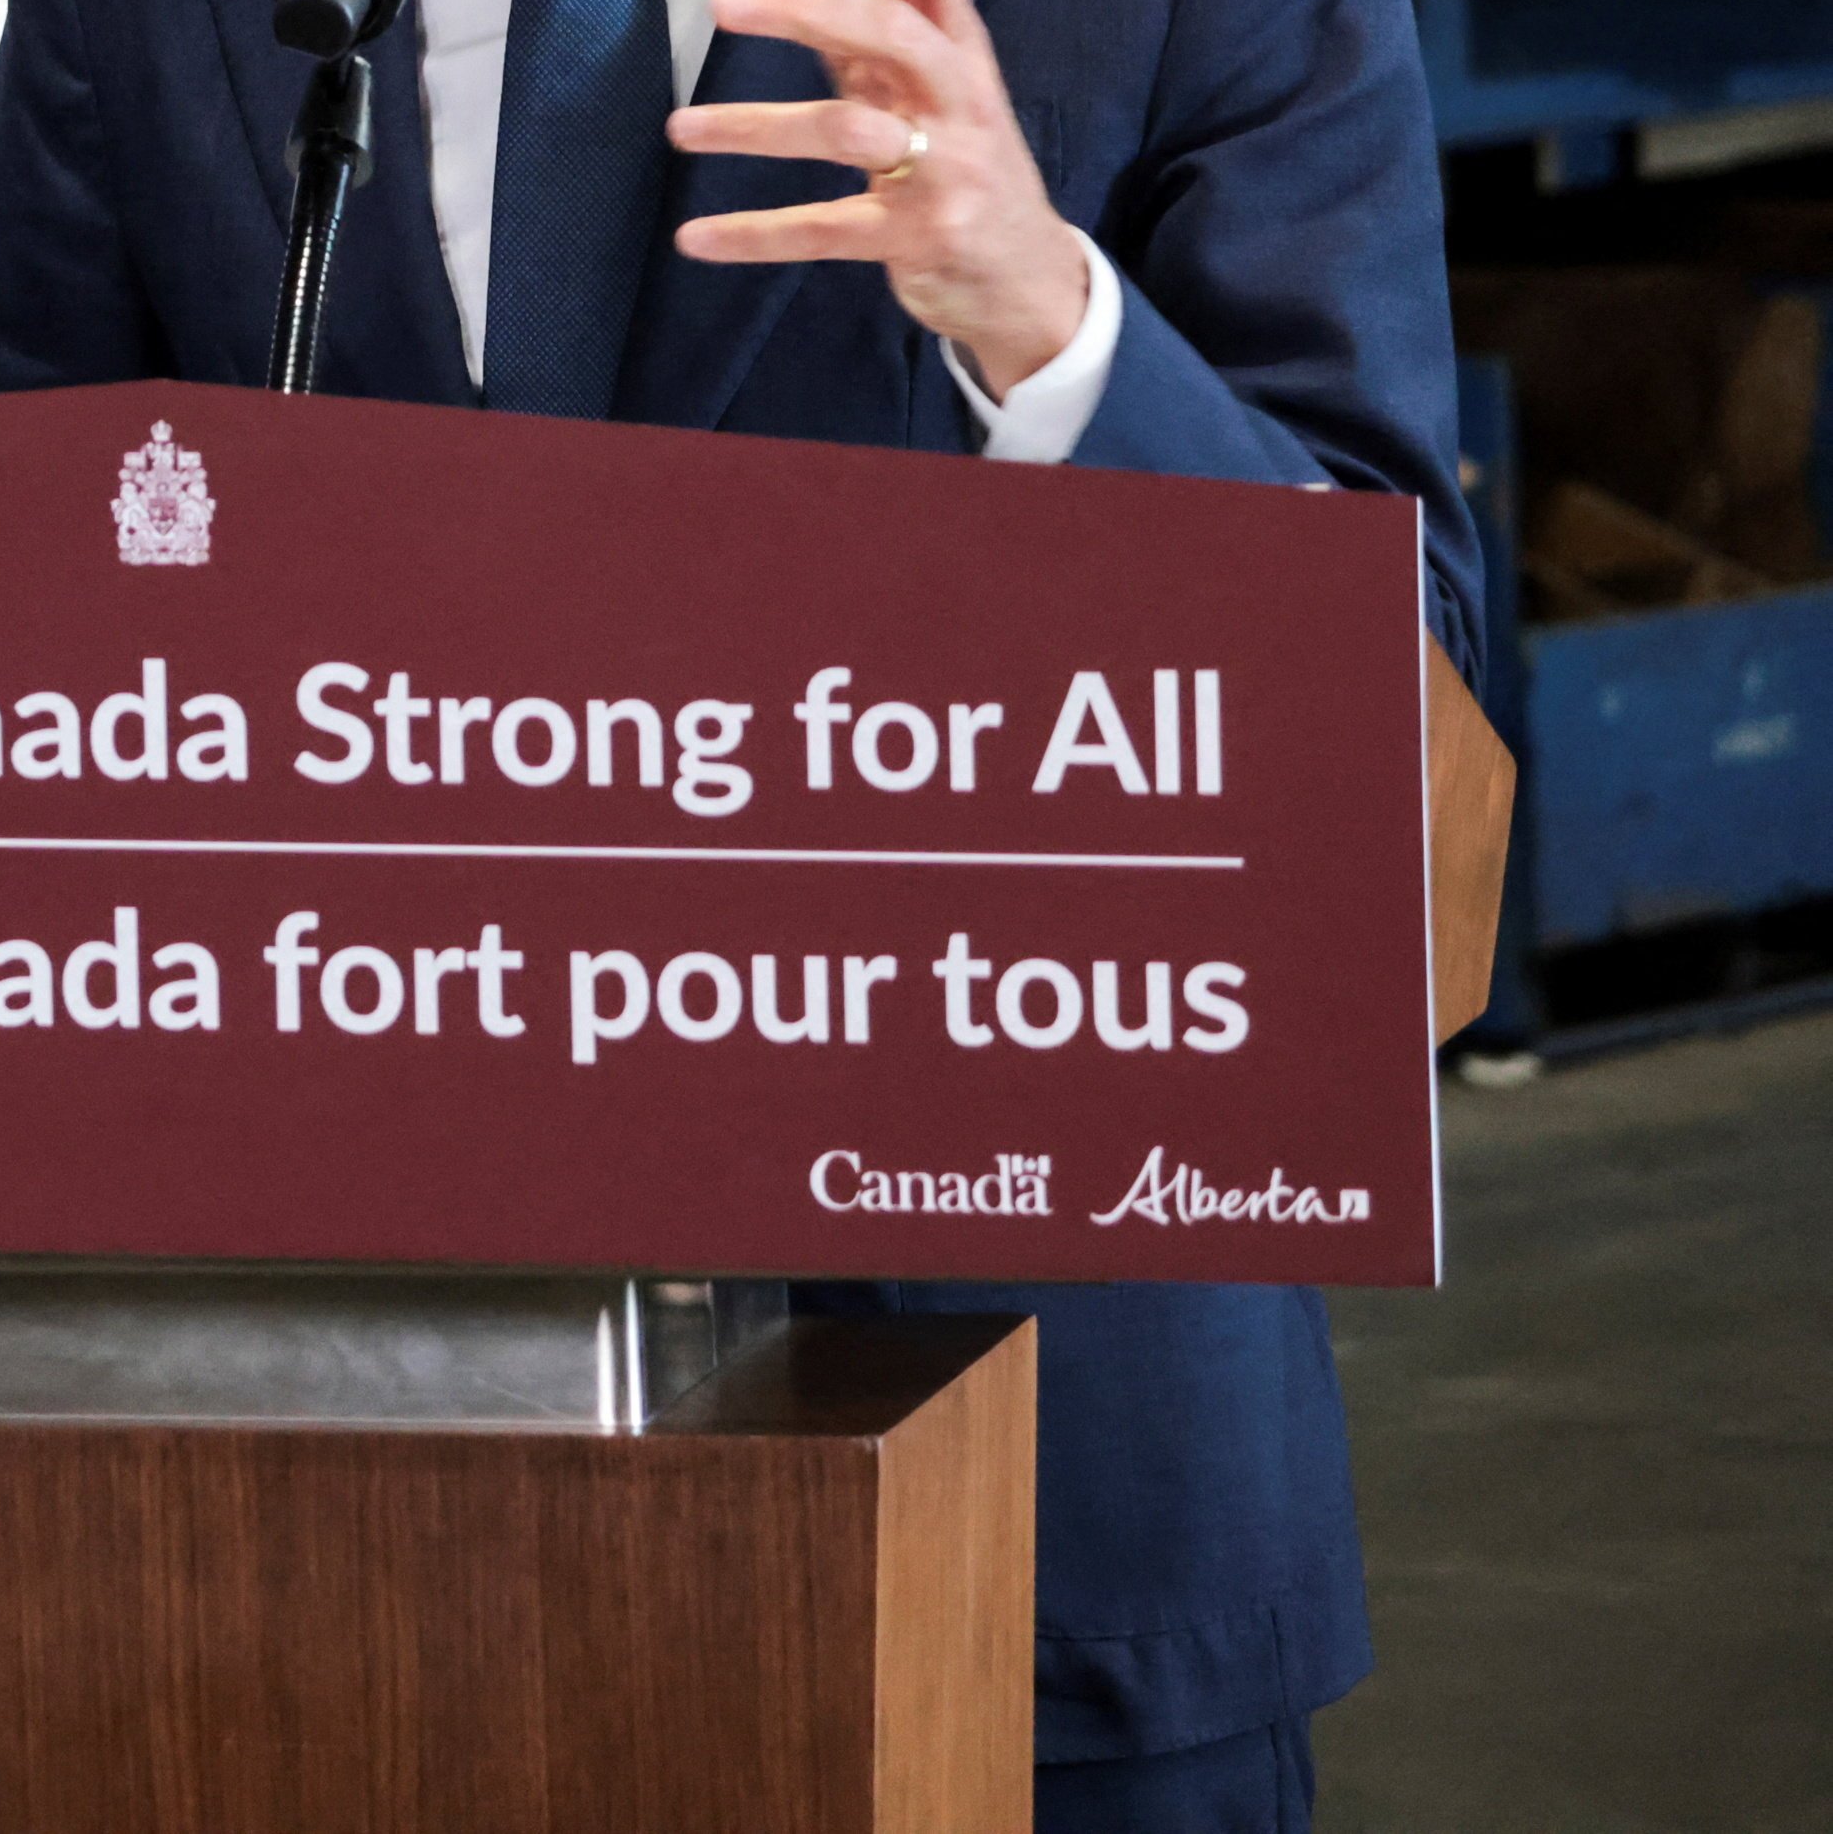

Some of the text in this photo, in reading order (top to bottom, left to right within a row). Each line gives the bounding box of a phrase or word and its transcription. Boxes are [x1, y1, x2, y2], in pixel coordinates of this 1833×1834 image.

[292, 660, 755, 818] Strong
[792, 665, 1005, 793] for
[1030, 667, 1224, 797] All
[262, 909, 527, 1039] fort
[568, 948, 899, 1066] pour
[931, 931, 1251, 1055] tous
[808, 1148, 1054, 1217] Canada
[1088, 1144, 1341, 1227] Alberta
